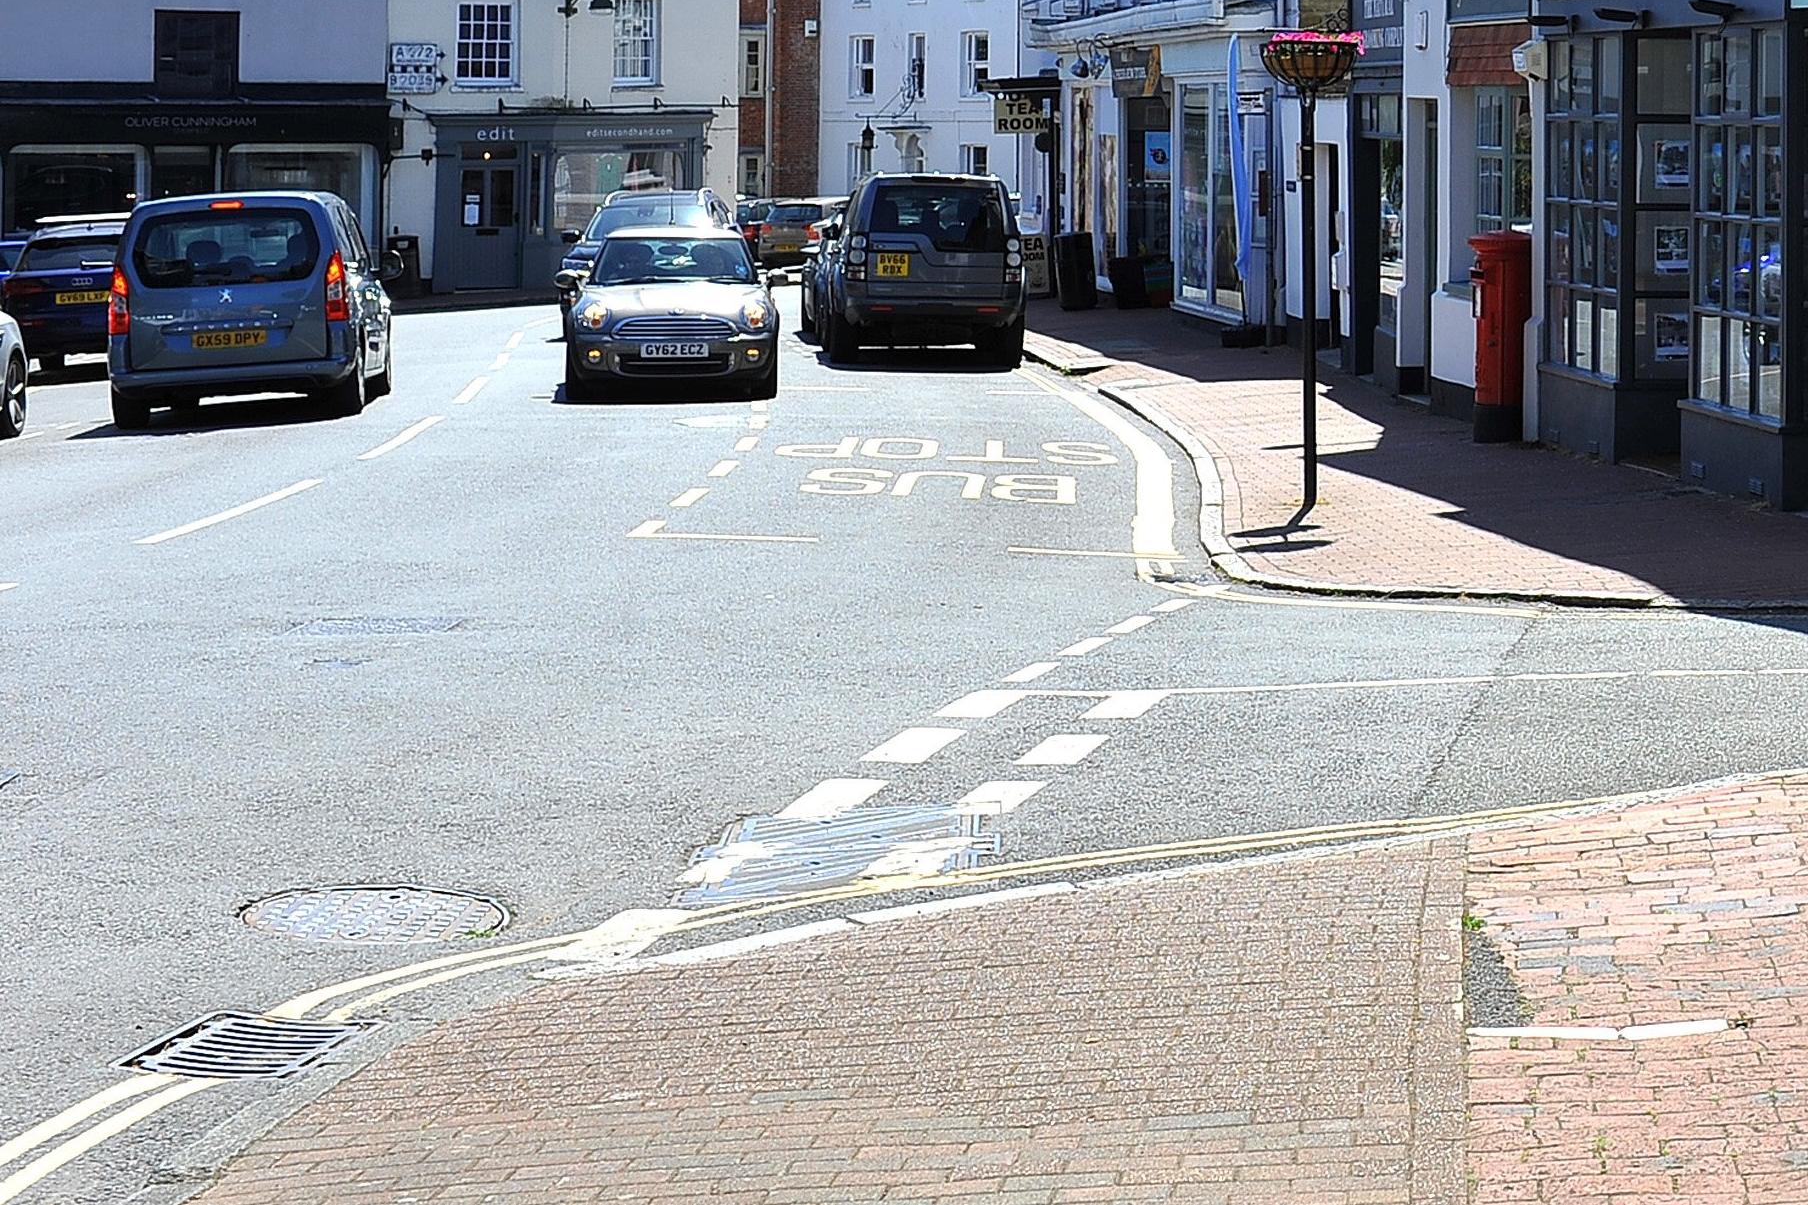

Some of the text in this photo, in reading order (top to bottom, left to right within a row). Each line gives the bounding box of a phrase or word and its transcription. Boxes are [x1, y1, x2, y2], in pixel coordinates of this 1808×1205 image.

[1005, 102, 1040, 115] TEA
[124, 116, 257, 127] OLIVER CUNNINGHAM
[997, 117, 1049, 131] ROOM
[476, 126, 516, 141] edit
[586, 127, 673, 138] editsecondhand.com
[1020, 237, 1044, 251] EA
[195, 331, 260, 347] GX59 DPY
[645, 344, 704, 356] GY62 ECZ
[774, 437, 1118, 465] STOP
[800, 467, 1077, 505] BUS
